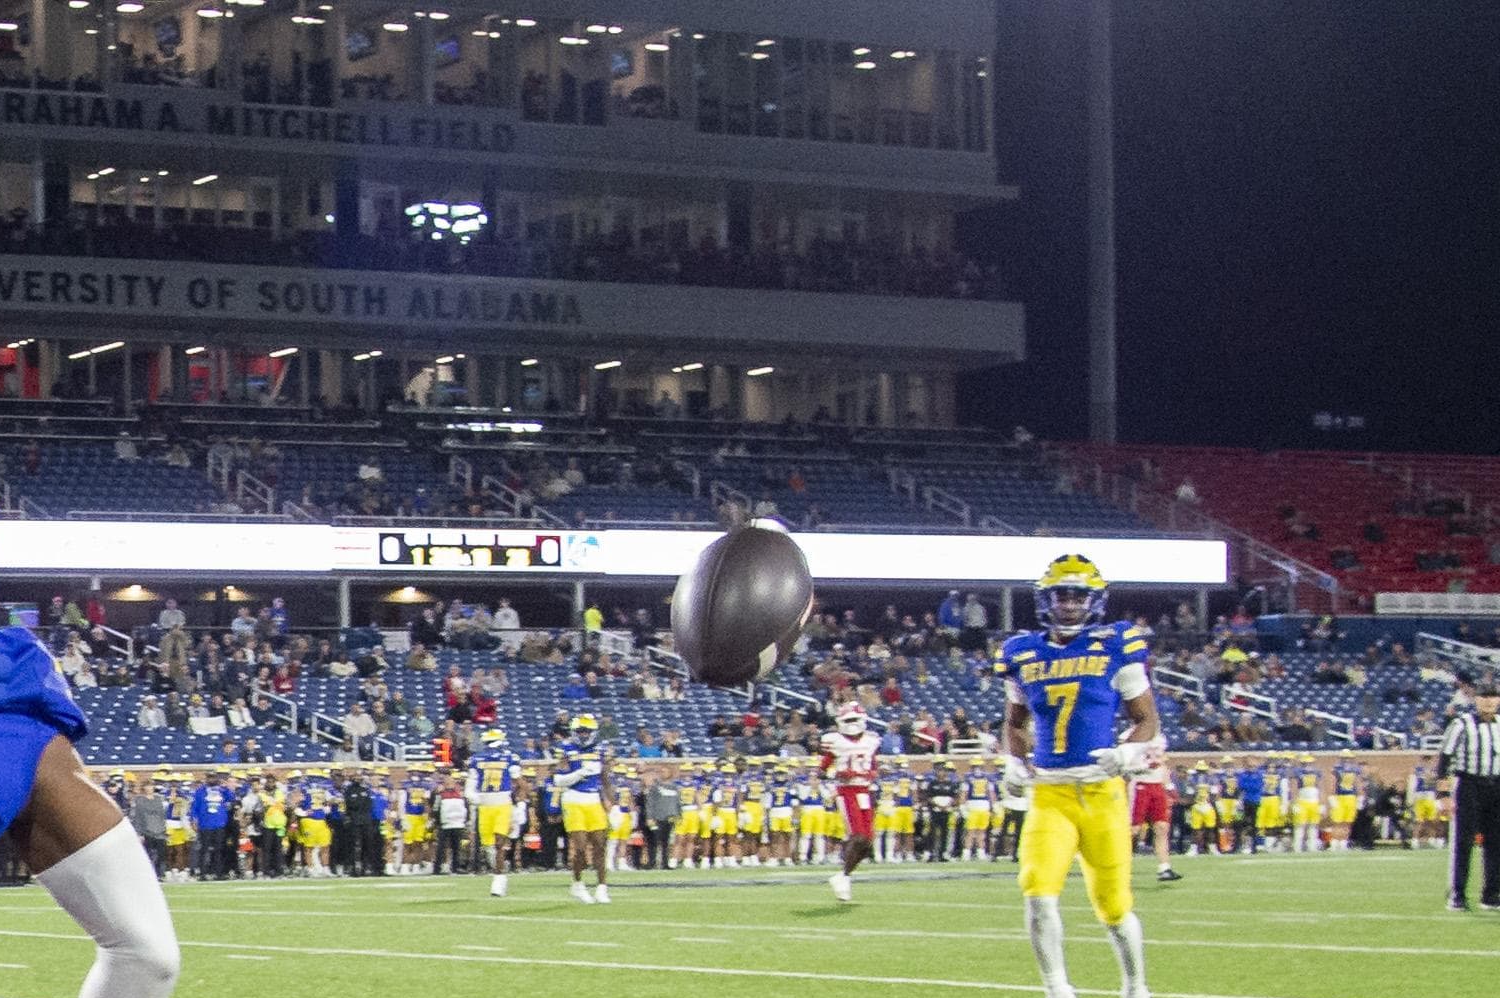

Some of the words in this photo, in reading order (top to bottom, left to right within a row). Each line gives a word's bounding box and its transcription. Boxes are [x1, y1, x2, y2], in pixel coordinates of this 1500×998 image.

[206, 104, 393, 147] MITCHELL
[409, 116, 516, 152] FIELD
[188, 278, 236, 310] OF
[257, 280, 387, 317] SOUTH
[406, 287, 583, 326] ALABAMA
[1044, 681, 1081, 754] 7
